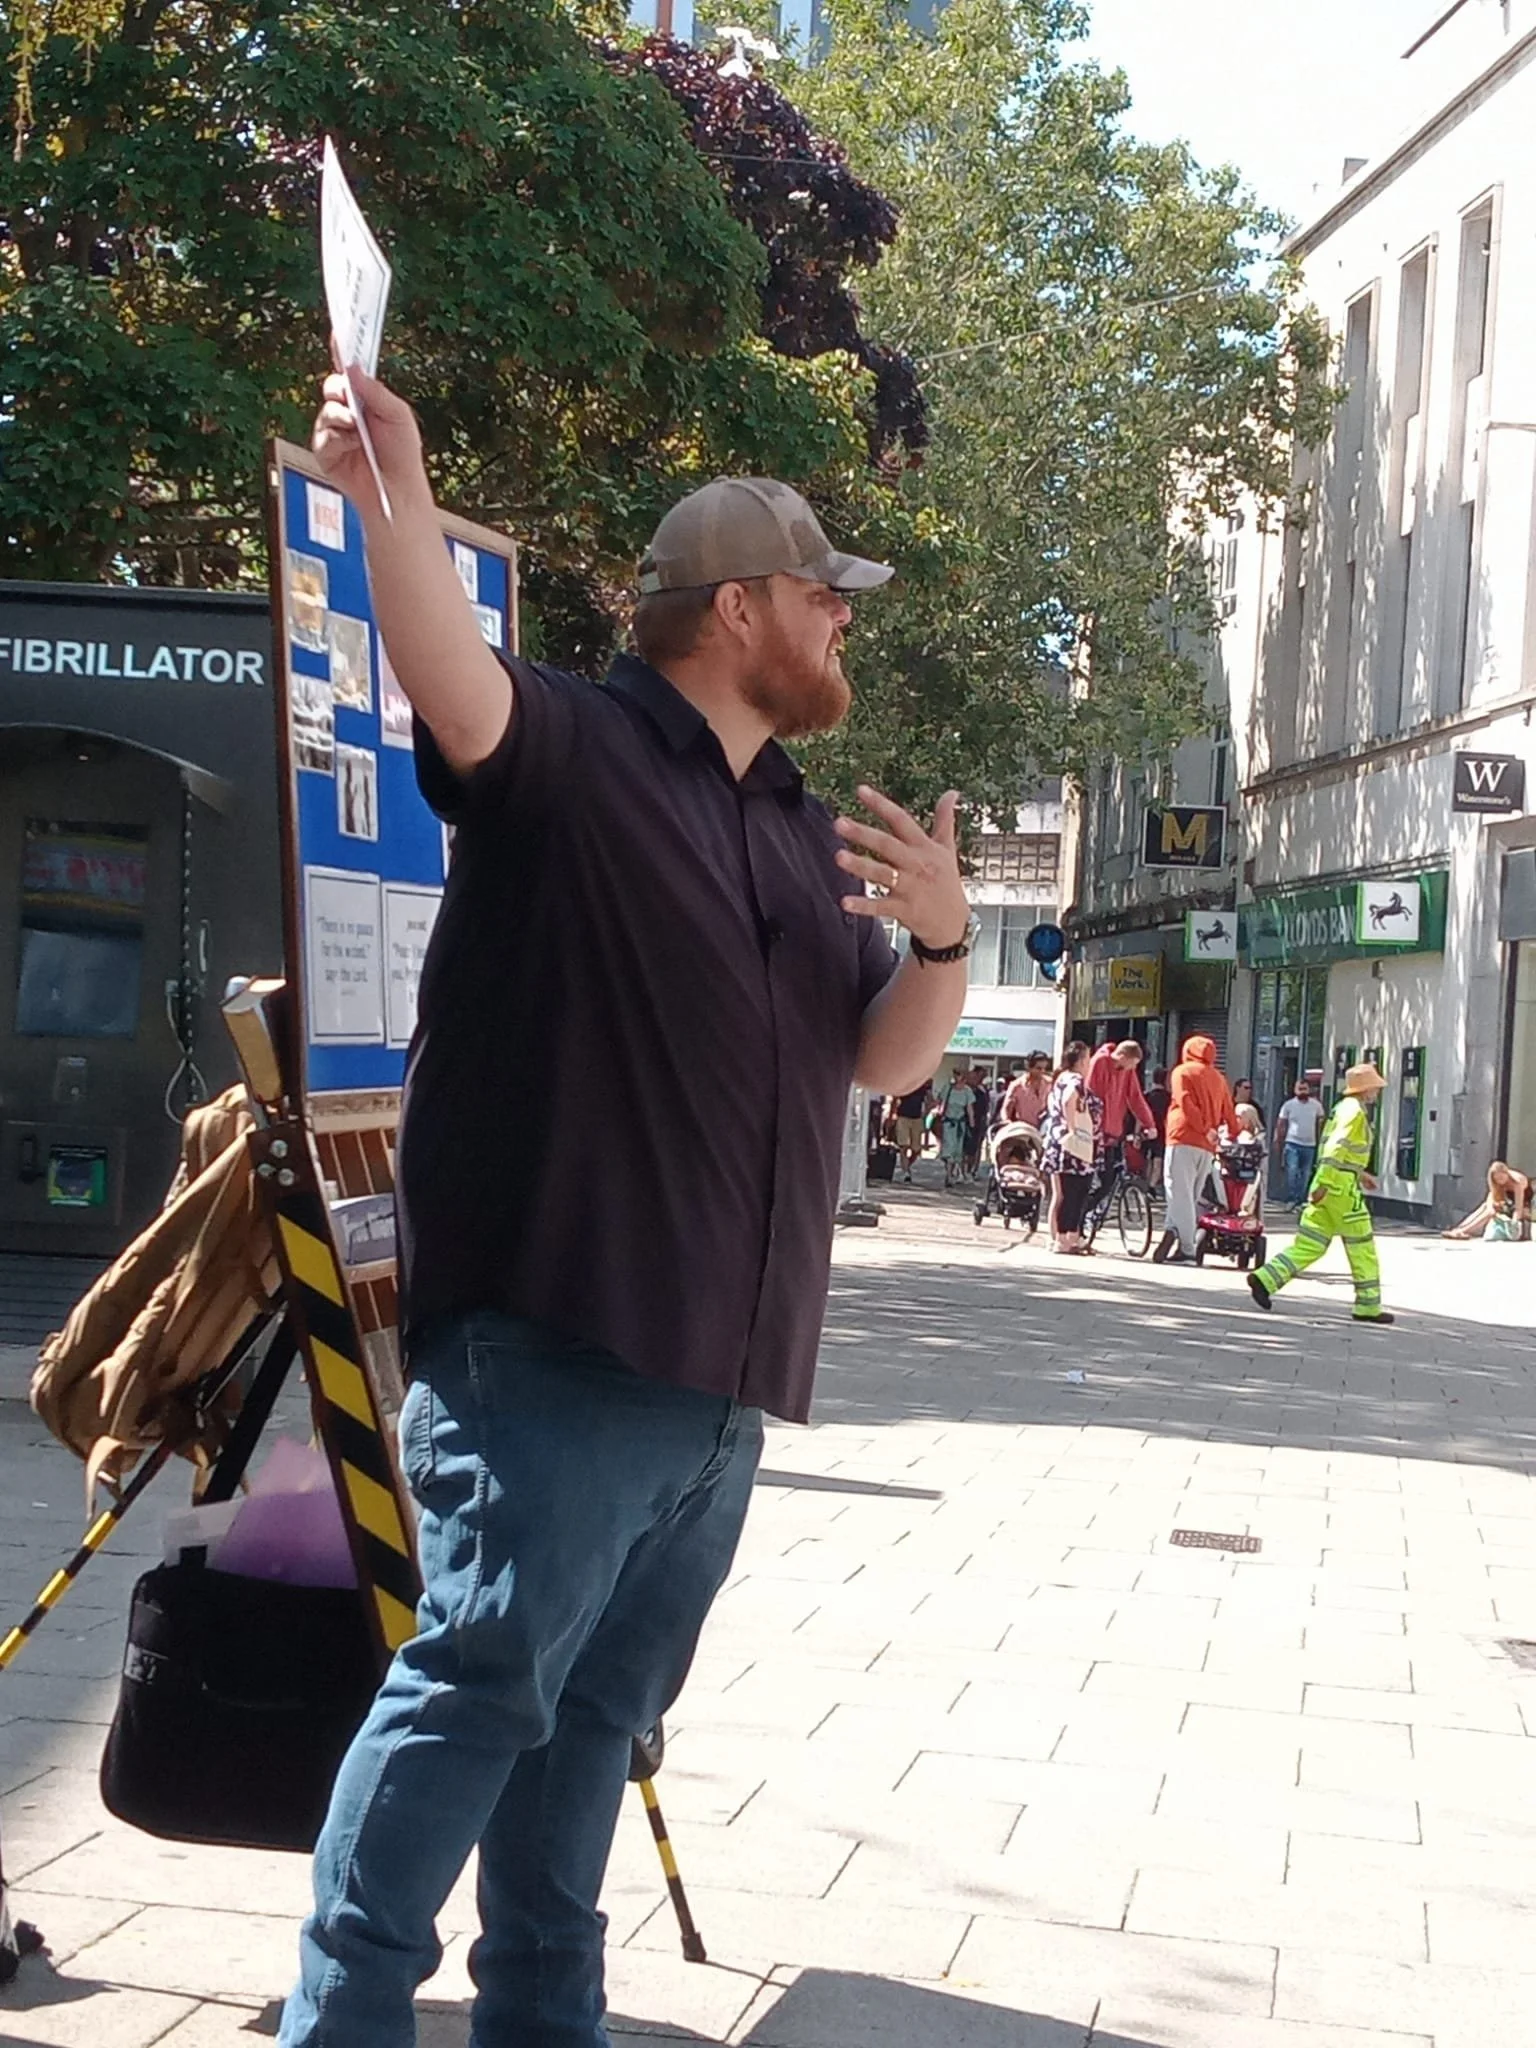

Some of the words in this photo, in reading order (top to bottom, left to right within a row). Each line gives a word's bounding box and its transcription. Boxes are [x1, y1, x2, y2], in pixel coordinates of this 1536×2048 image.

[1463, 760, 1509, 792] W
[1161, 812, 1208, 855] M
[1329, 904, 1356, 945] BAN
